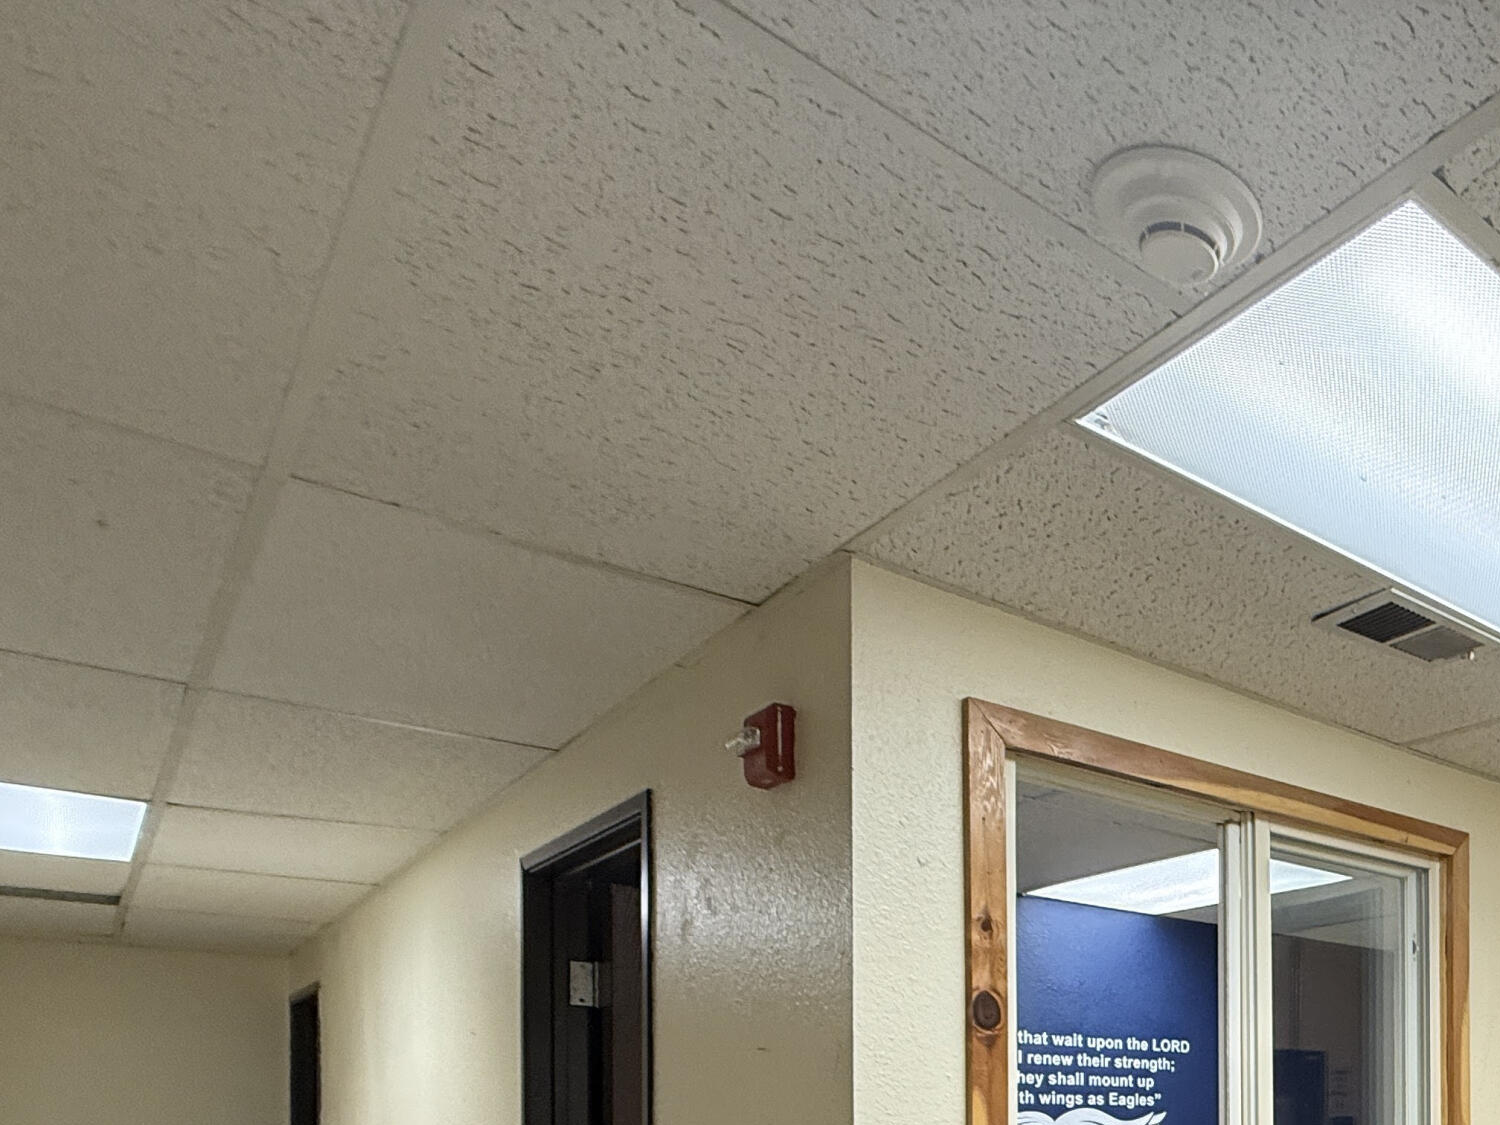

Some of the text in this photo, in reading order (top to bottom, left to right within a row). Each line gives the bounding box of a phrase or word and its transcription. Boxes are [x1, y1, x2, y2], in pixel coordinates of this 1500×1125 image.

[1018, 1030, 1190, 1053] that wait upon the LORD
[1027, 1053, 1073, 1066] renew
[1077, 1053, 1111, 1068] their
[1114, 1056, 1176, 1073] strength;
[1017, 1070, 1155, 1090] hey shall mount up
[1019, 1090, 1034, 1104] th
[1039, 1091, 1083, 1108] wings
[1087, 1093, 1105, 1106] as
